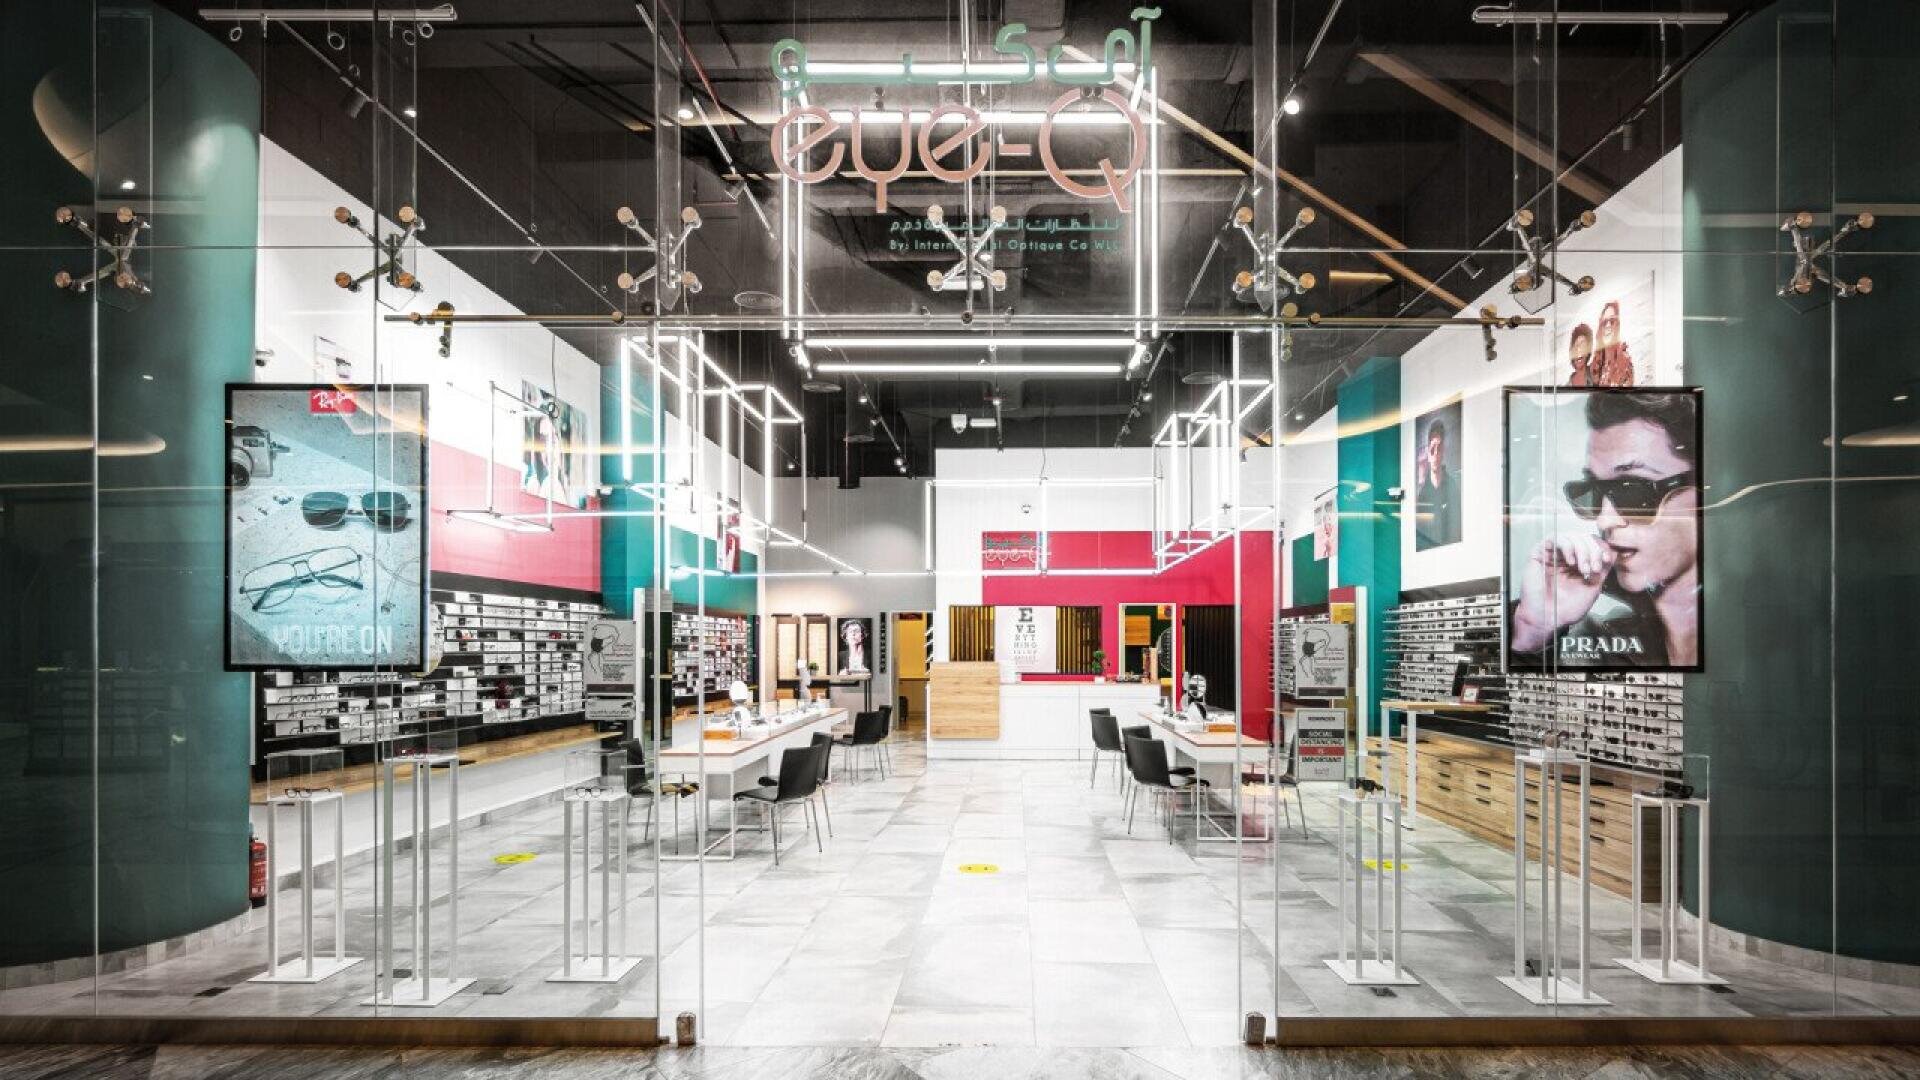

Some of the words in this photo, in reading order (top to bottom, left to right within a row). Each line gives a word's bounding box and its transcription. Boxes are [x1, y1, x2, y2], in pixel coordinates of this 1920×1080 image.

[770, 87, 1147, 214] eye-Q
[1008, 239, 1063, 253] Optique
[273, 625, 355, 654] YOU'RE
[360, 625, 392, 654] ON
[1560, 636, 1643, 653] PRADA
